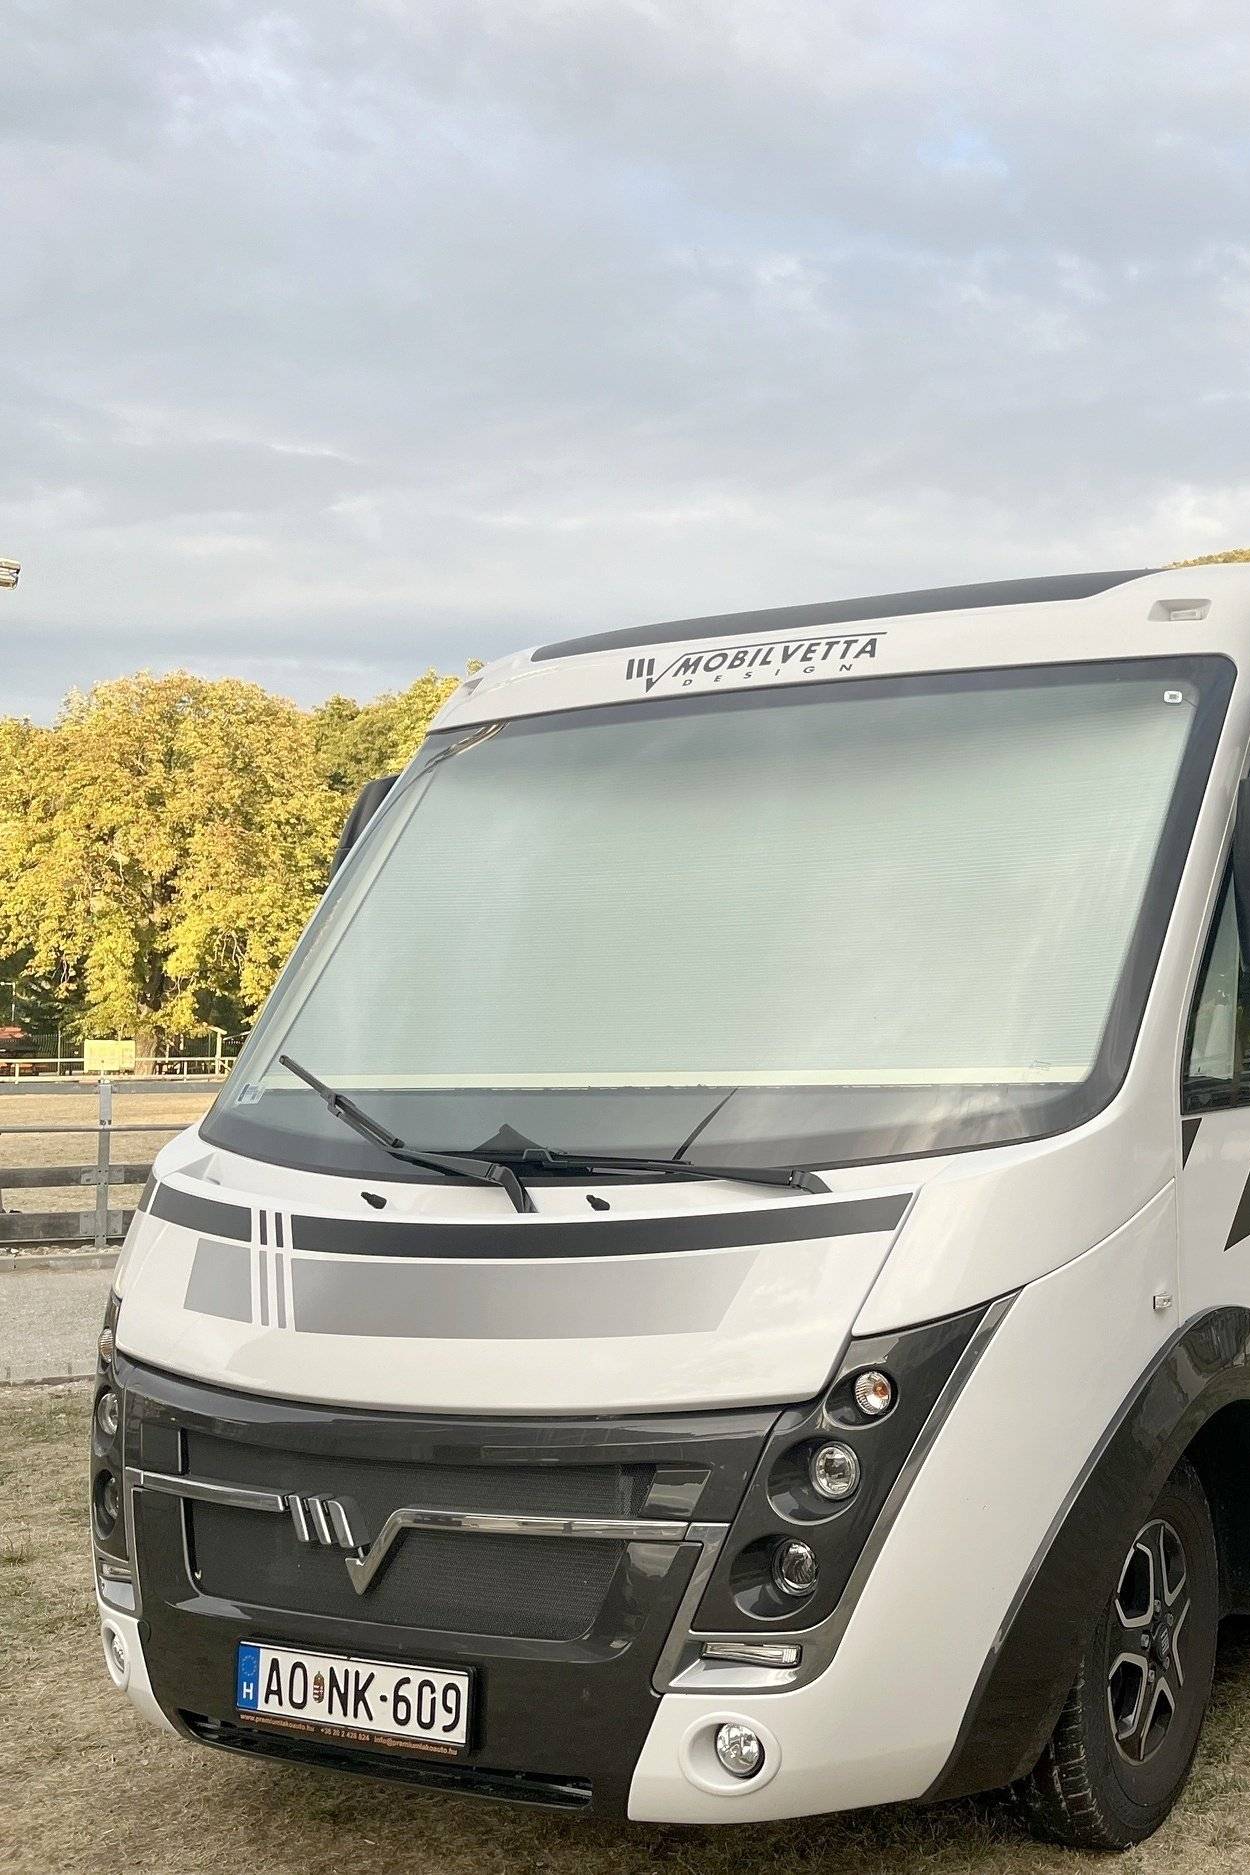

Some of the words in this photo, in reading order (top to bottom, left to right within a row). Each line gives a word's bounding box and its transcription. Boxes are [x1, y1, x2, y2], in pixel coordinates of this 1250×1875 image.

[671, 637, 878, 678] MOBILVETTA
[682, 664, 853, 687] DESIGN
[242, 1682, 254, 1700] H
